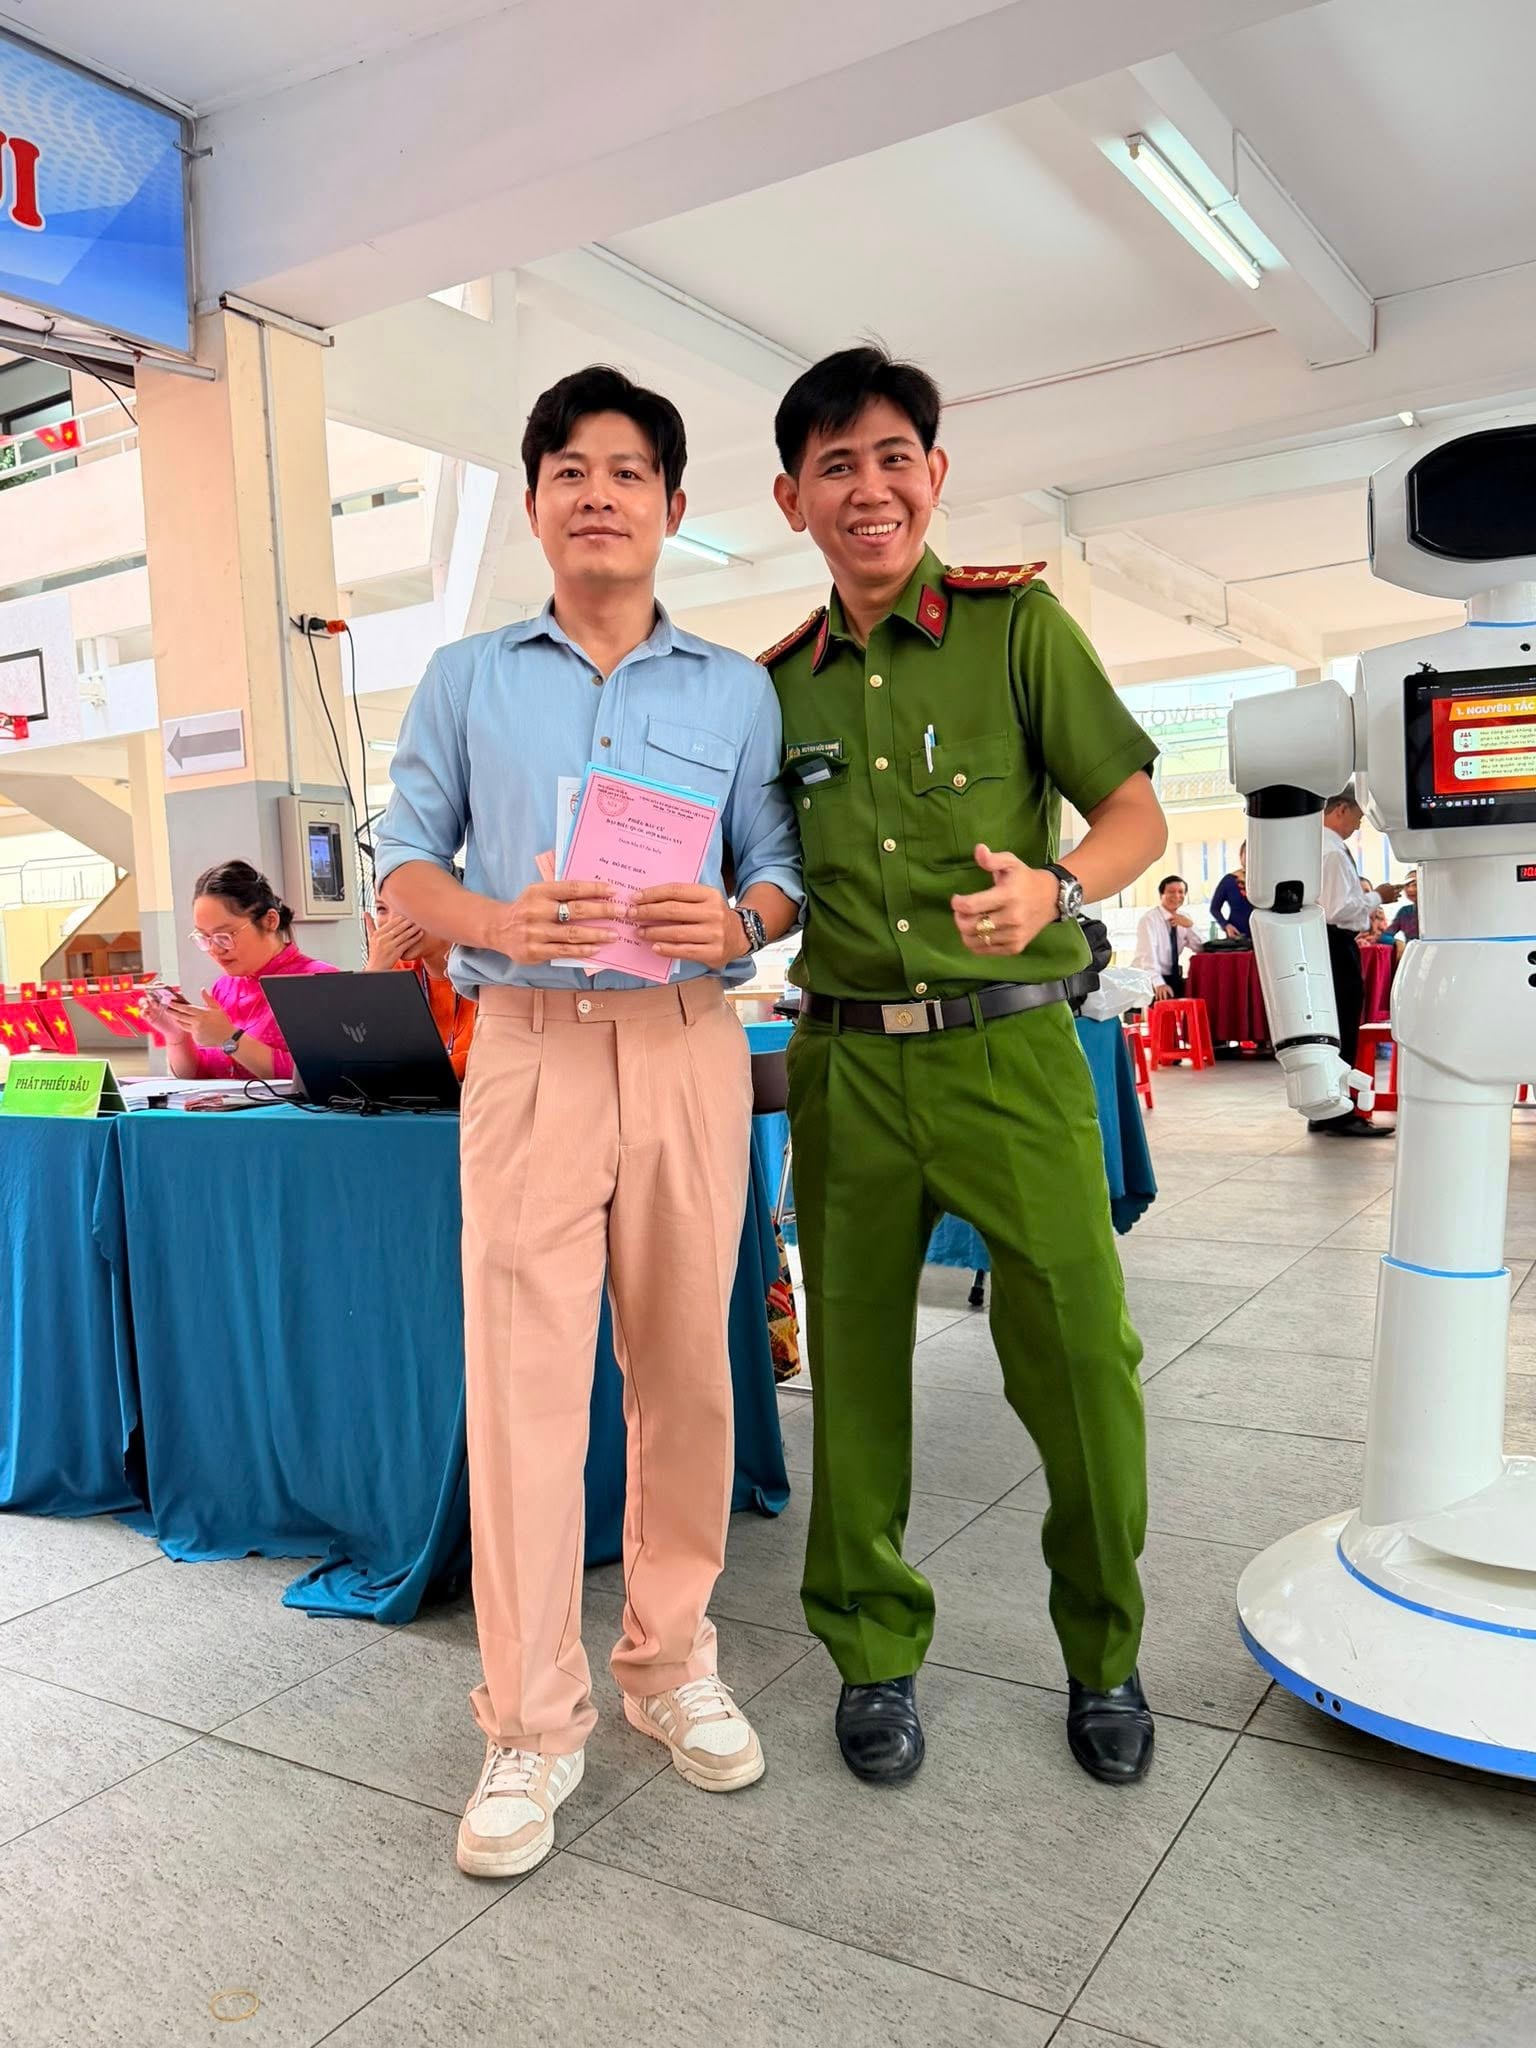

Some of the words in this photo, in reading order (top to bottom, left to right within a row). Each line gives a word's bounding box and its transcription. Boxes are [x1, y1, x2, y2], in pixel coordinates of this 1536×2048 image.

[0, 129, 43, 228] I
[15, 1076, 39, 1090] PHÁT
[40, 1075, 69, 1091] PHIẾU
[69, 1075, 90, 1091] BẦU
